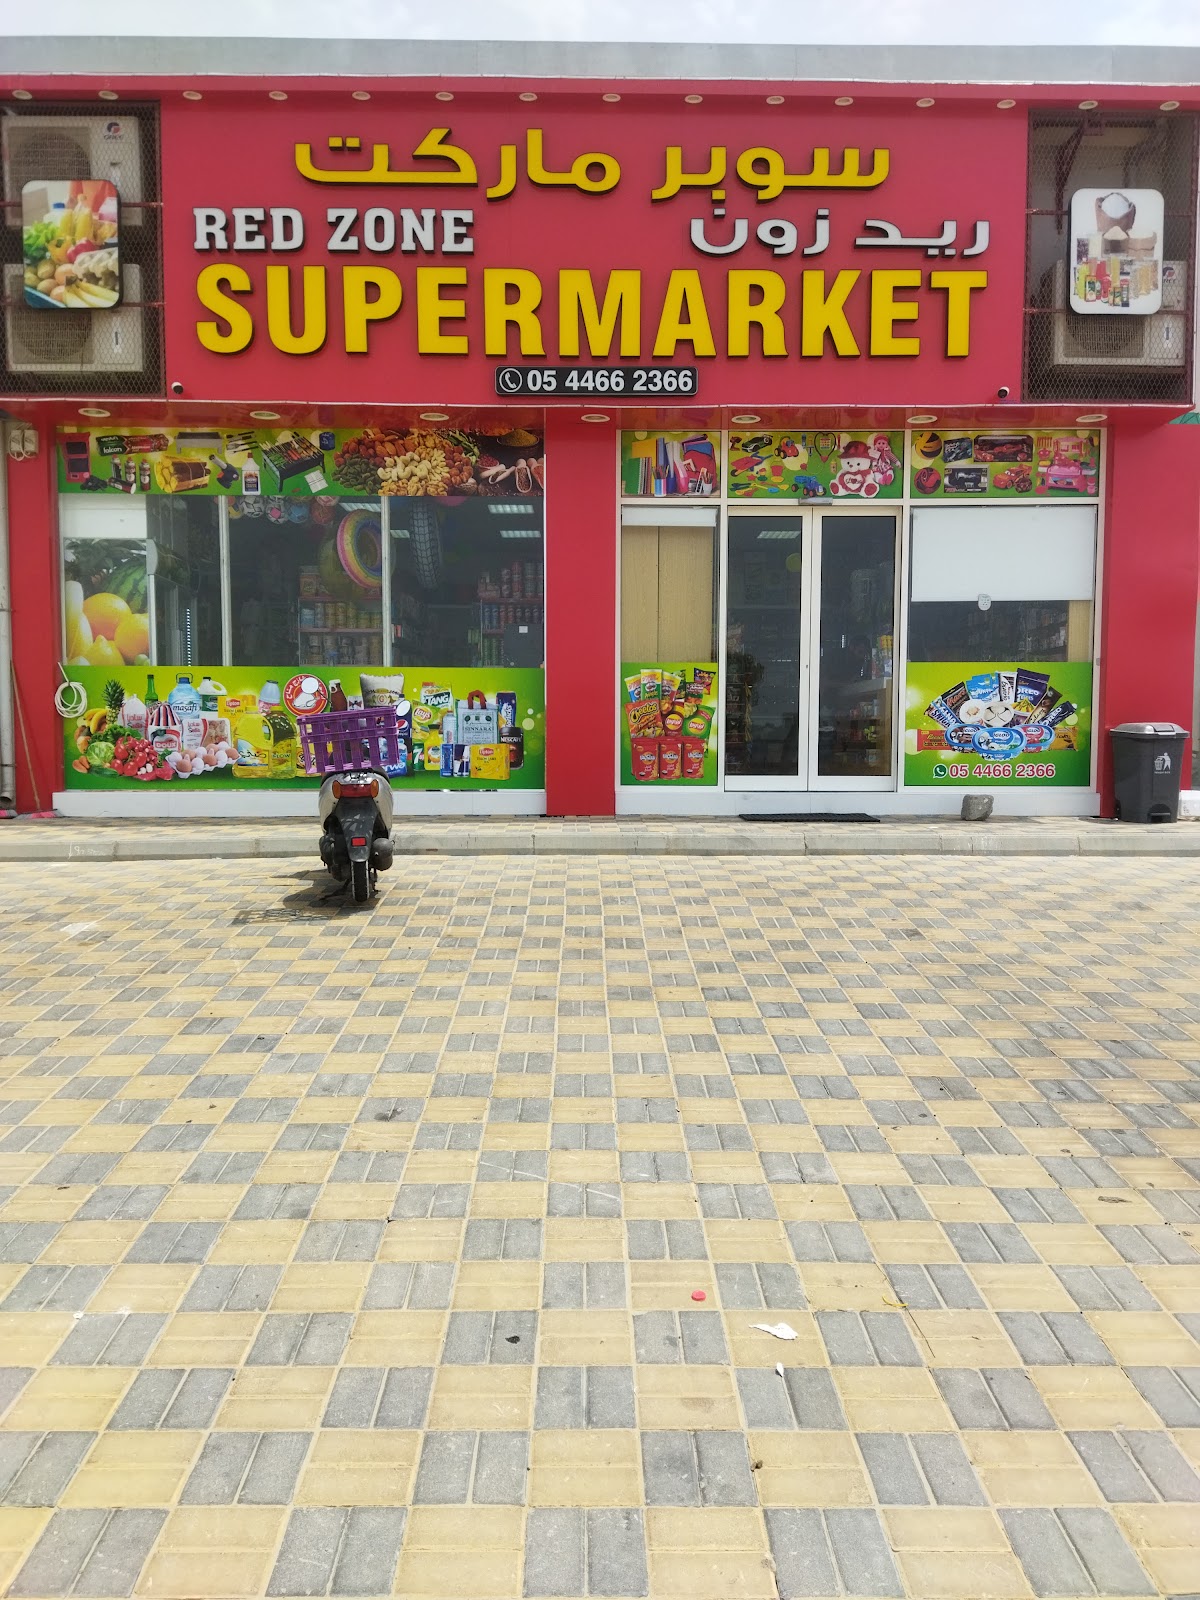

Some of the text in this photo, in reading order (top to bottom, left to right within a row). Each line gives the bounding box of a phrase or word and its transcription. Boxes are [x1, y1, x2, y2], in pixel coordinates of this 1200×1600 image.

[294, 127, 891, 202] سوبر ماركت
[193, 207, 475, 254] RED ZONE
[690, 208, 991, 258] ريد زون
[195, 263, 989, 359] SUPERMARKET
[527, 369, 693, 391] 05 4466 2366
[103, 446, 122, 454] falcon
[172, 702, 198, 712] masafi
[424, 694, 449, 706] TANG
[629, 702, 658, 723] Cheetos
[1042, 707, 1062, 726] OREO
[949, 763, 1056, 778] 05 4466 2366
